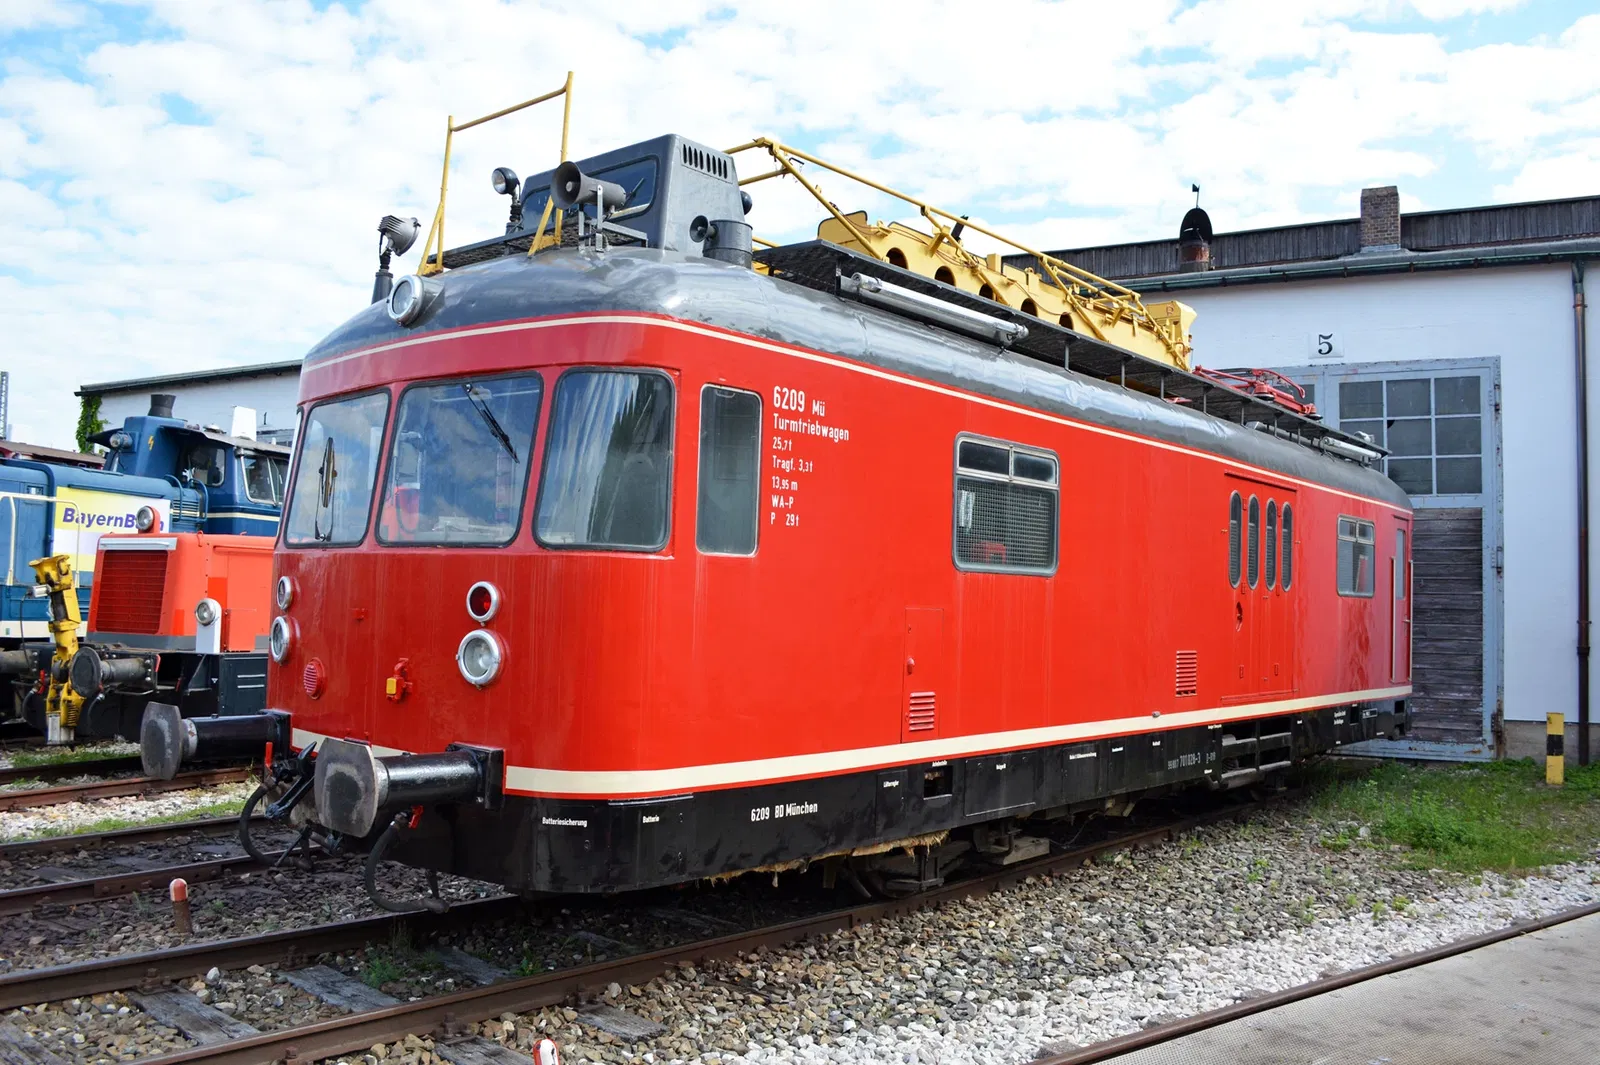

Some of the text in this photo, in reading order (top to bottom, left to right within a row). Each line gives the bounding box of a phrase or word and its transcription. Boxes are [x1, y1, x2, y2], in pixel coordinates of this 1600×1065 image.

[1318, 333, 1333, 355] 5
[773, 386, 826, 417] 6209 Mü
[773, 413, 850, 443] Turmtriebwagen
[771, 494, 794, 508] WA-P
[62, 507, 165, 531] BayernBn
[770, 512, 776, 525] P
[542, 816, 588, 828] Batteriesicherung
[751, 806, 770, 822] 6209
[785, 801, 818, 817] München
